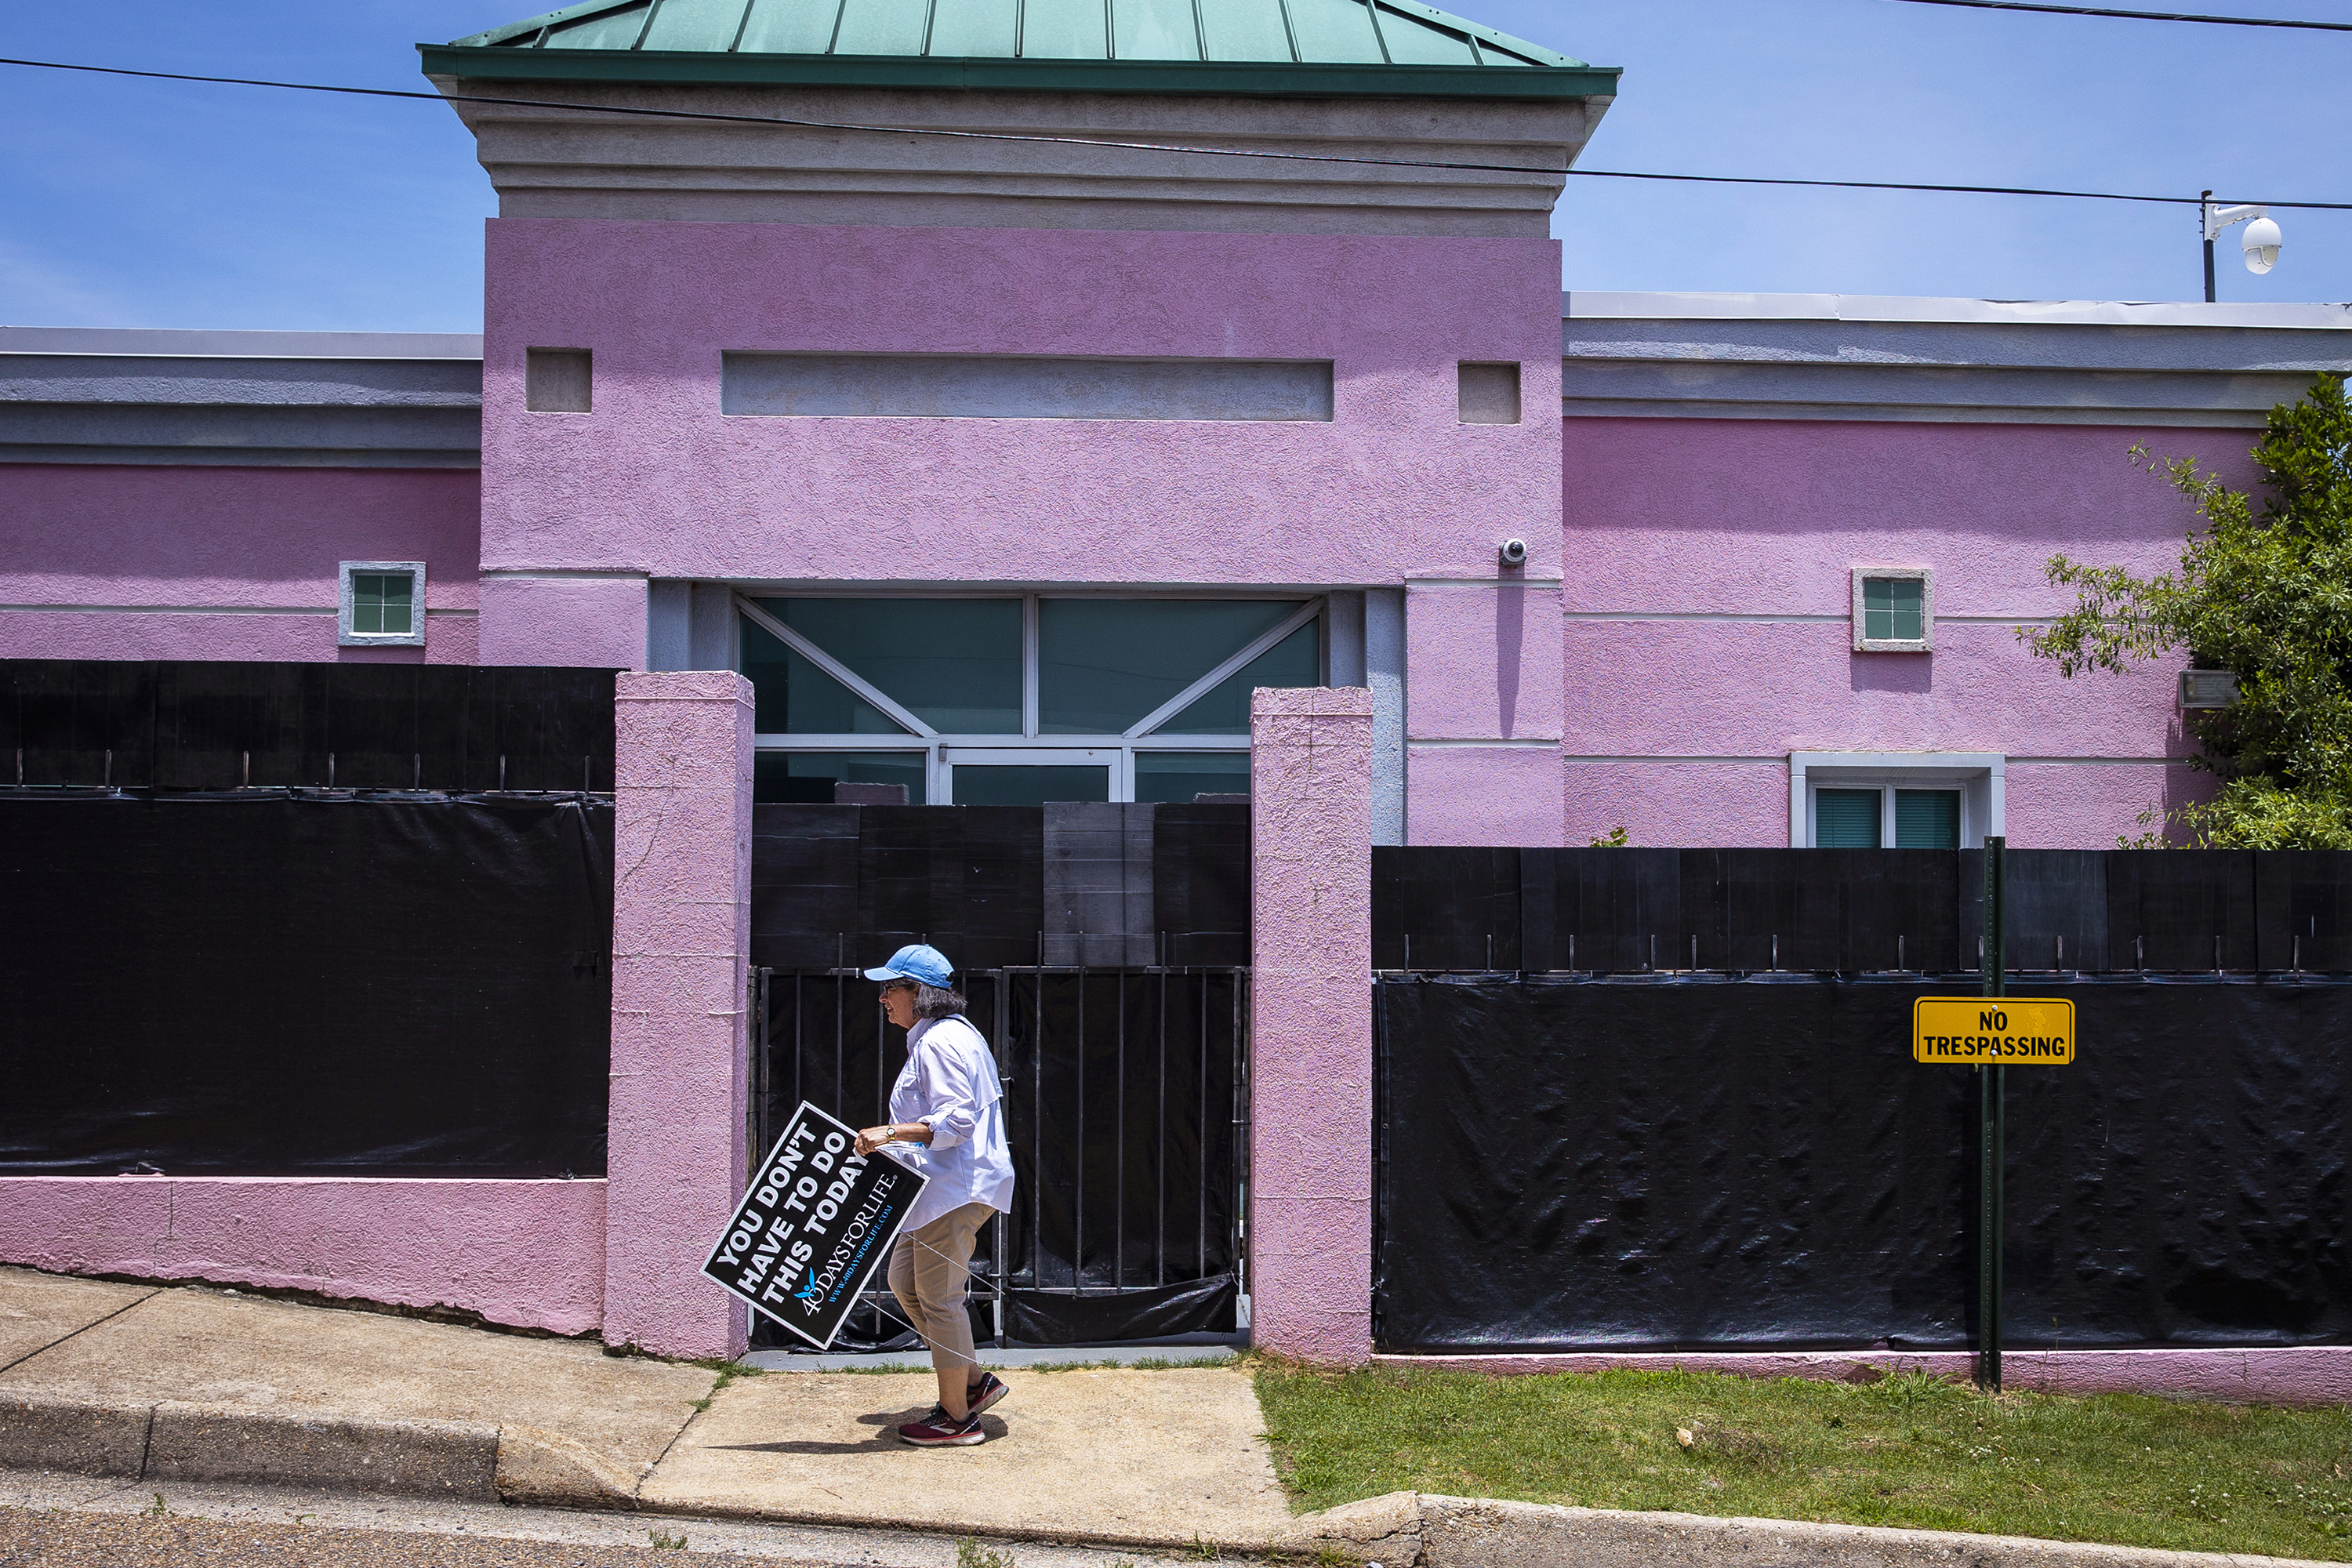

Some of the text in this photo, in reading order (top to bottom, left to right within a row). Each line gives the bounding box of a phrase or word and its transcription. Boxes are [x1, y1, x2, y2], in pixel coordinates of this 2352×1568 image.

[1923, 1036, 2065, 1056] TRESPASSING
[1980, 1011, 2008, 1032] NO
[717, 1121, 816, 1266] YOU DON'T
[737, 1131, 846, 1294] HAVE TO DO
[762, 1146, 869, 1304] THIS TODAY
